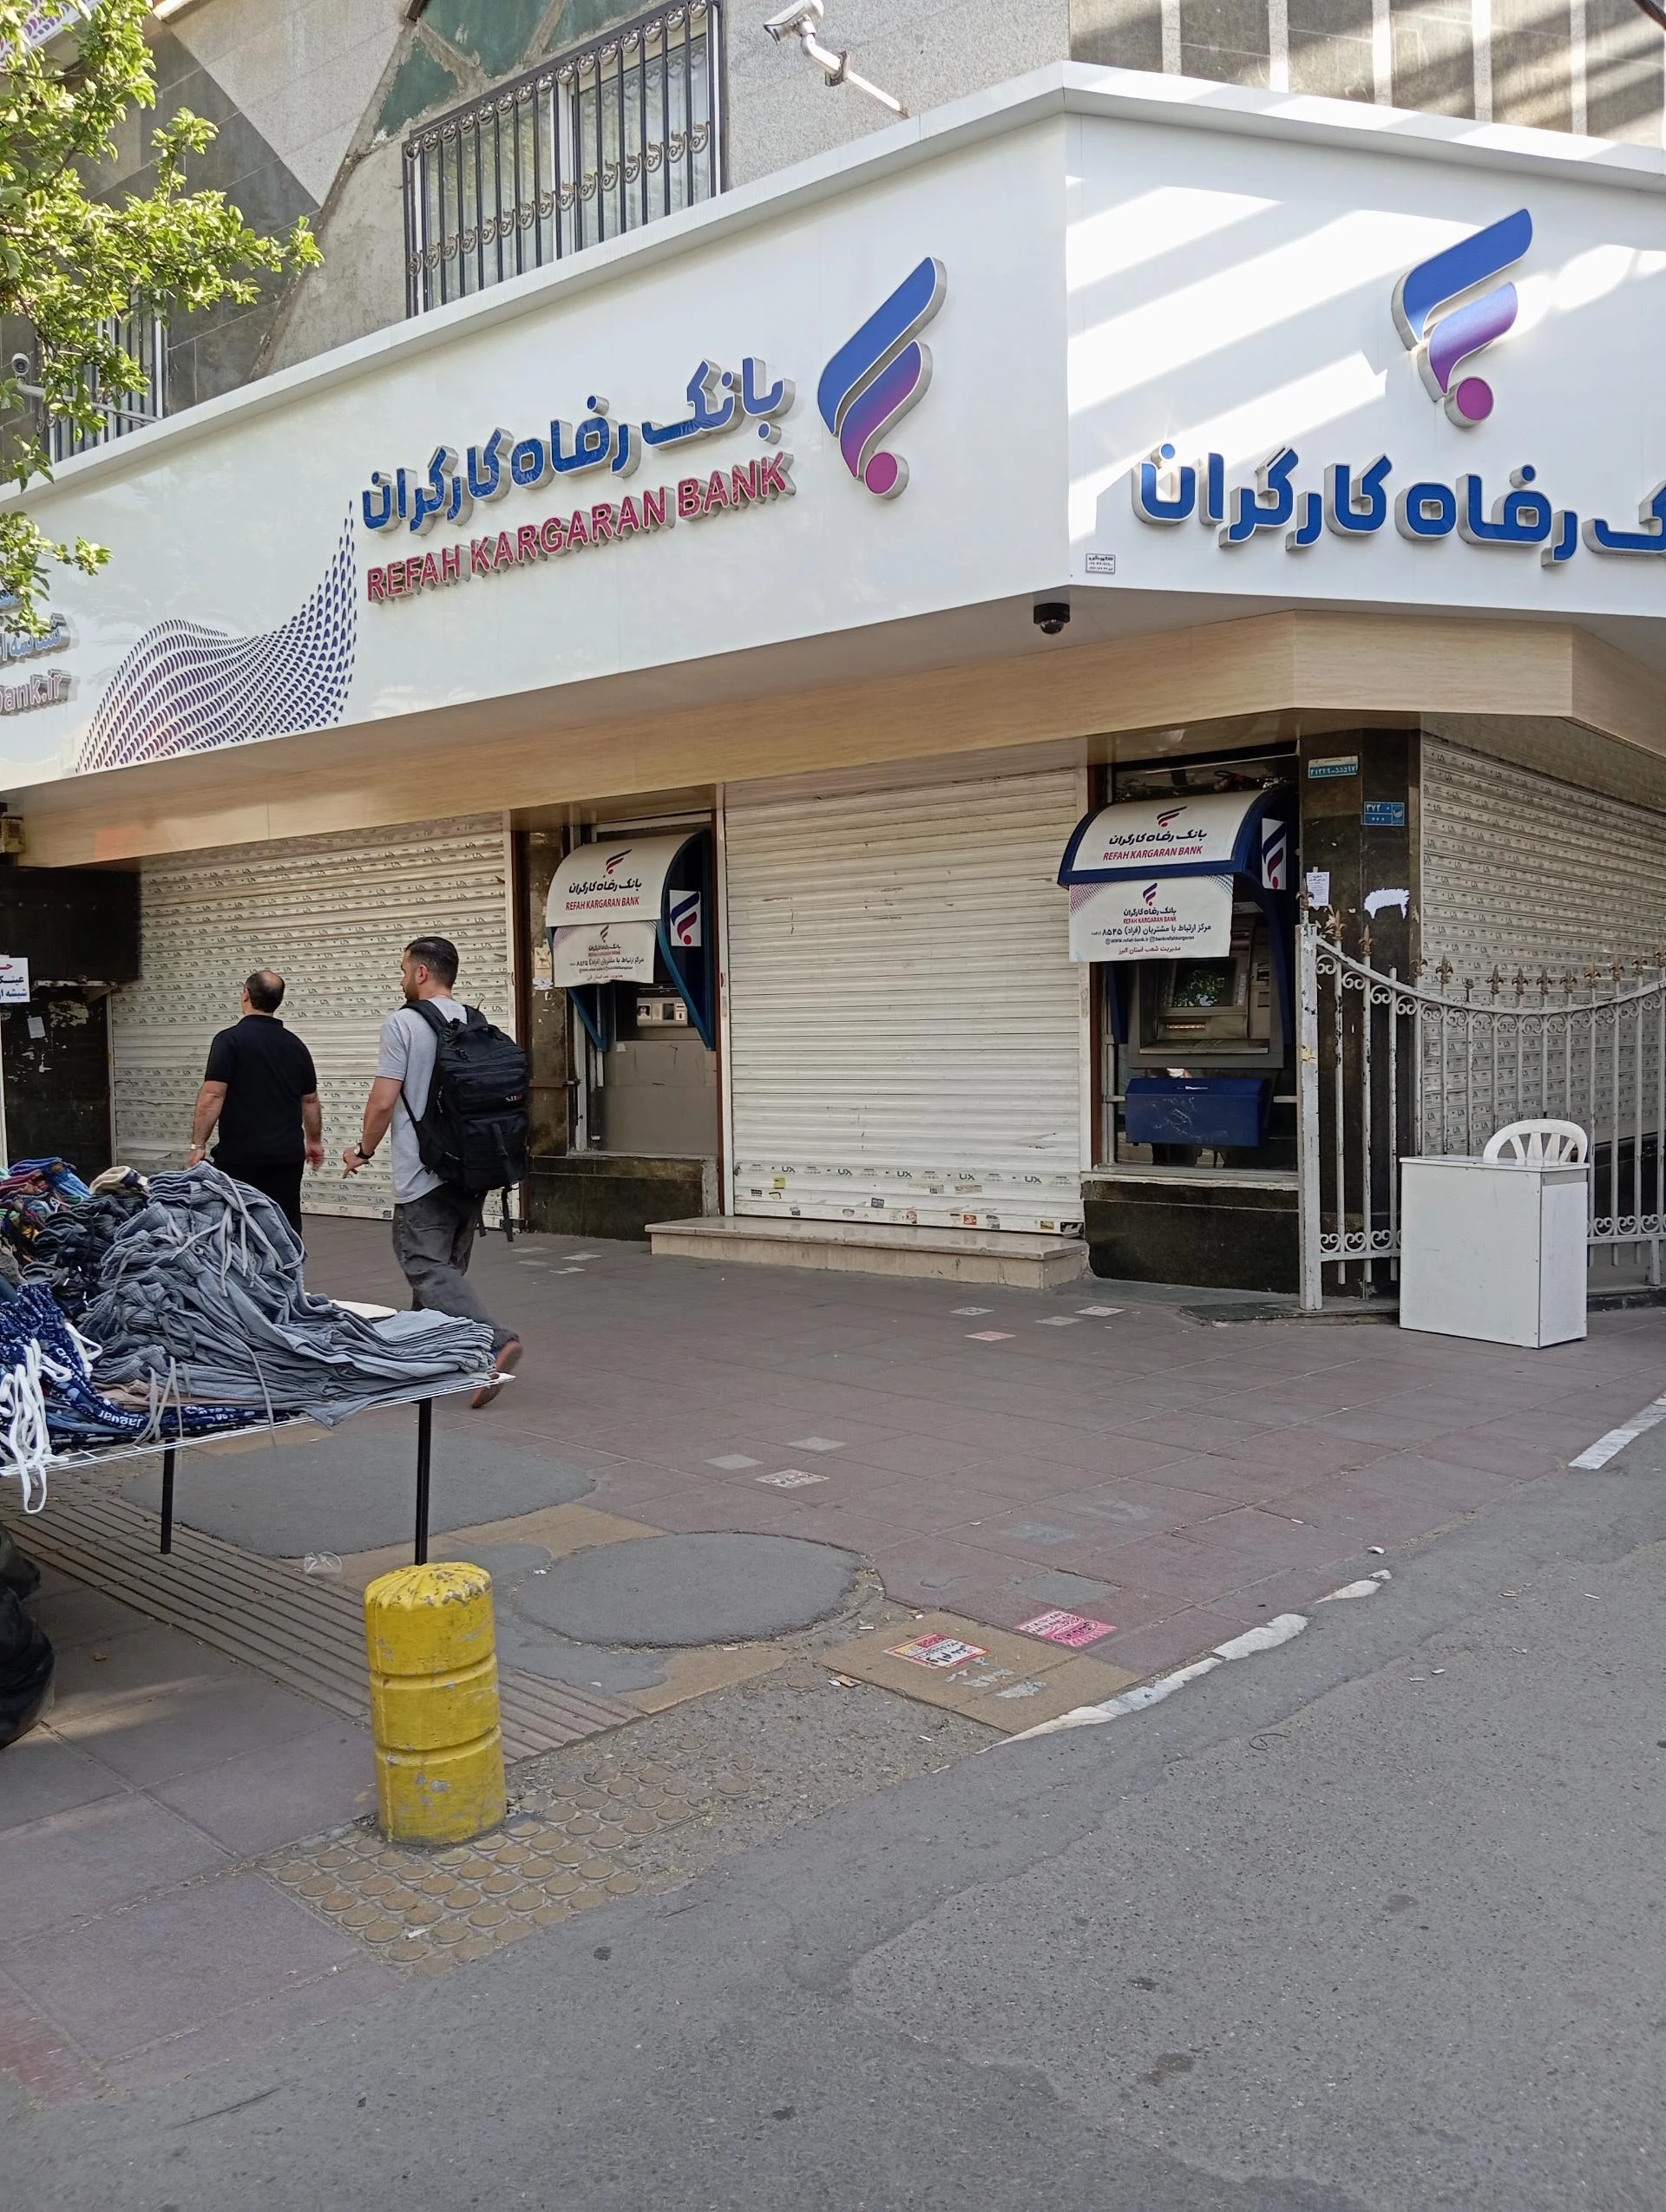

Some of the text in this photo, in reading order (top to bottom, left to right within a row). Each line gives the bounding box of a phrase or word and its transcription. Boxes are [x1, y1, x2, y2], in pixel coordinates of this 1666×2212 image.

[362, 357, 786, 534] بانک رفاه کارگران
[1133, 442, 1394, 550] کارگران
[1400, 462, 1580, 564] رفاه
[366, 450, 791, 603] REFAH KARGARAN BANK
[1108, 828, 1208, 845] بانک رفاه کارگران
[1102, 845, 1203, 861] REFAH KARGARAN BANK
[568, 880, 597, 894] کارگران
[618, 878, 642, 892] بانک
[565, 896, 640, 911] REFAH KARGARAN BANK
[97, 1410, 144, 1428] Jaguar
